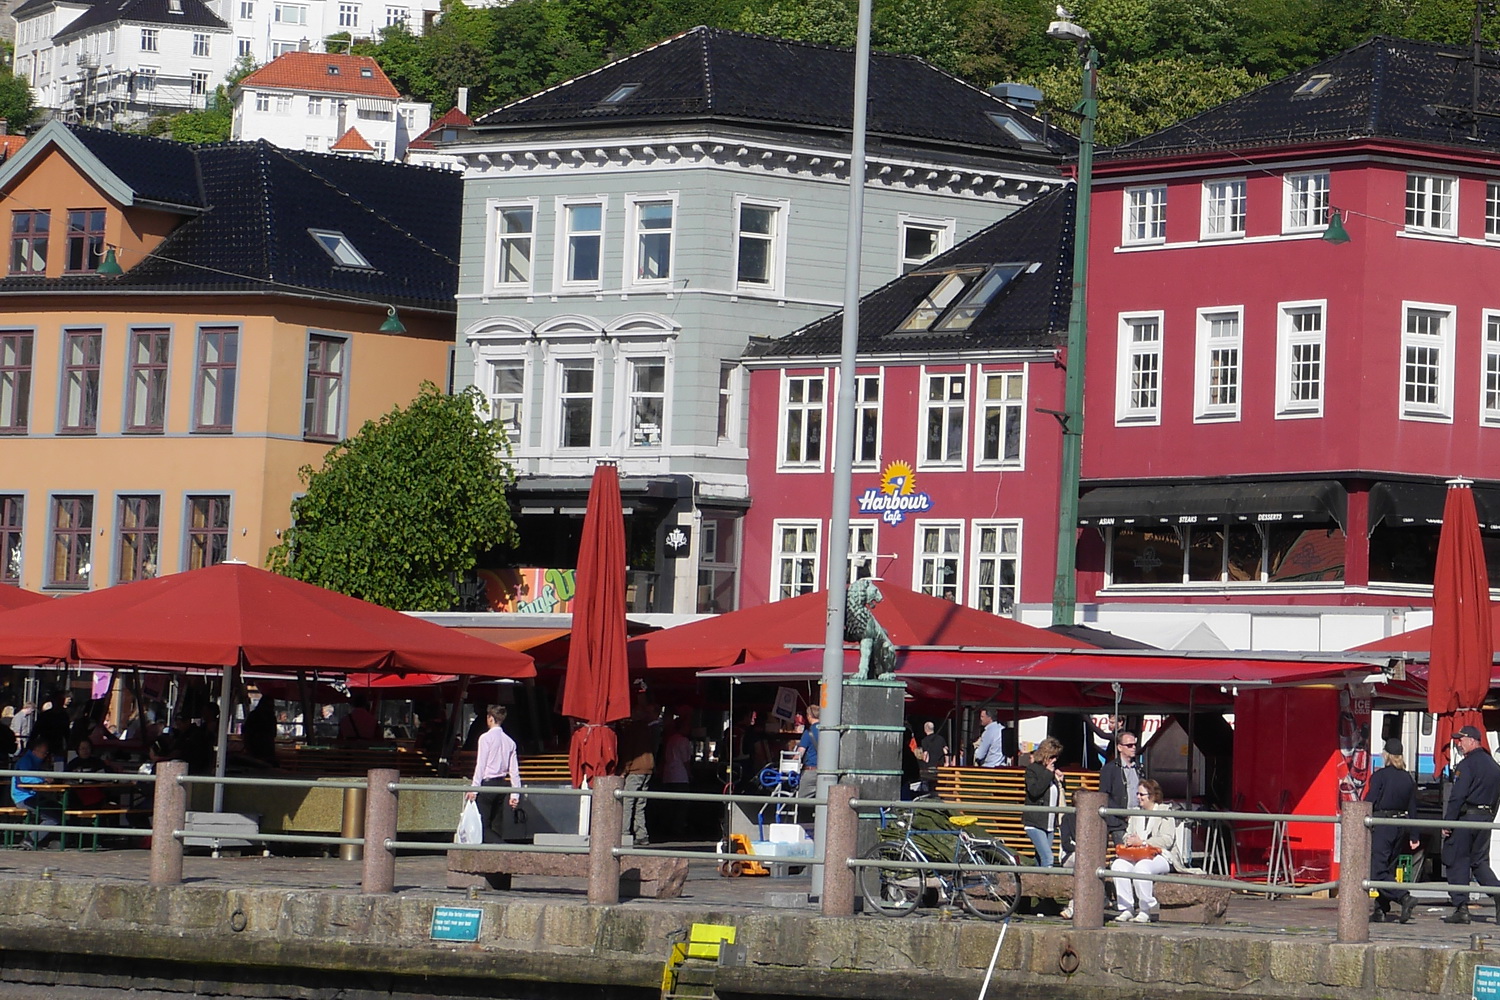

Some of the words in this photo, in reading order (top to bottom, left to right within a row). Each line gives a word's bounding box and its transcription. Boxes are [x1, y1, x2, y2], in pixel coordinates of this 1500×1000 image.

[858, 490, 929, 511] Harbour
[883, 510, 902, 526] Cafe
[1354, 700, 1371, 709] ICE
